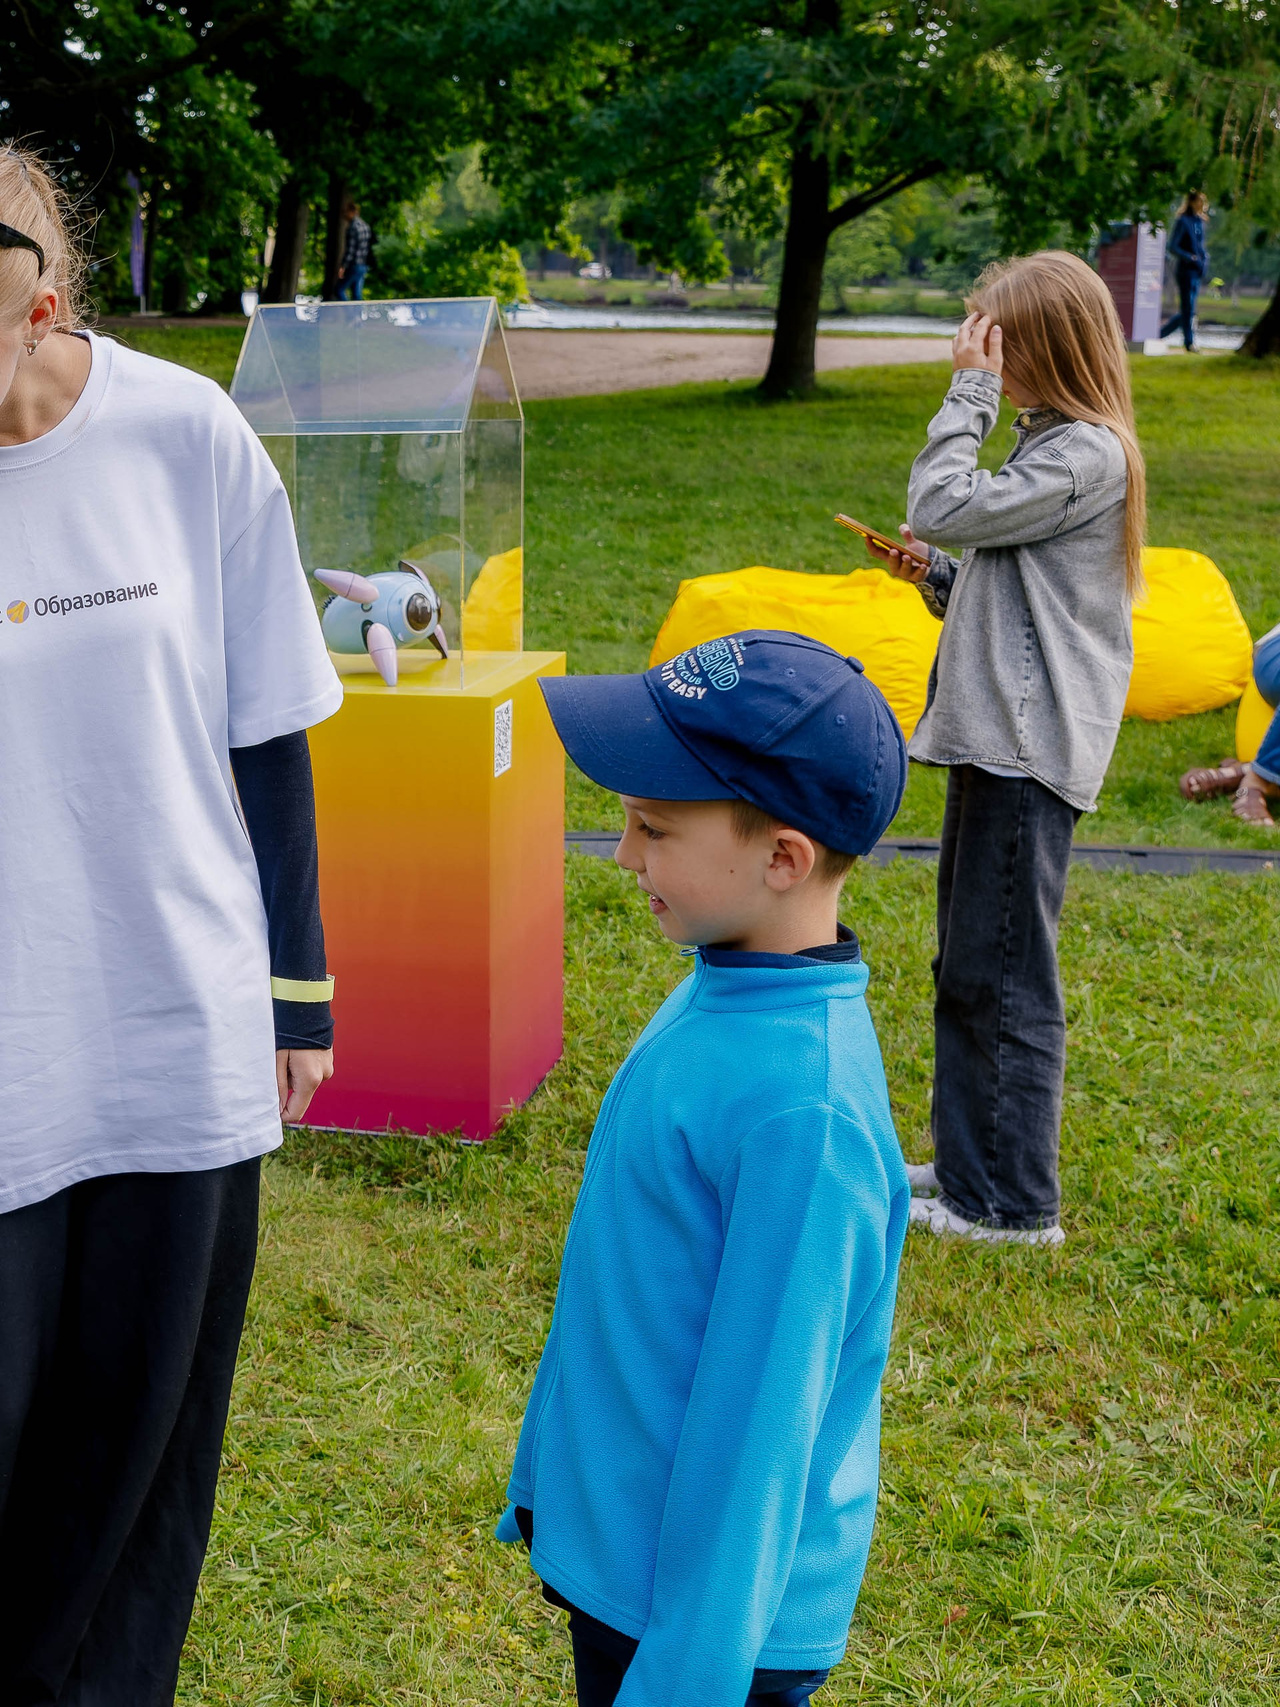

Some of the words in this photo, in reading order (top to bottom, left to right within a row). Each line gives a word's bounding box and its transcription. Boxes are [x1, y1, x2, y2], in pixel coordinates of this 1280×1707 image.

[33, 582, 159, 617] Образование
[661, 669, 676, 681] IT
[680, 670, 703, 685] CLUB
[667, 678, 708, 700] EASY
